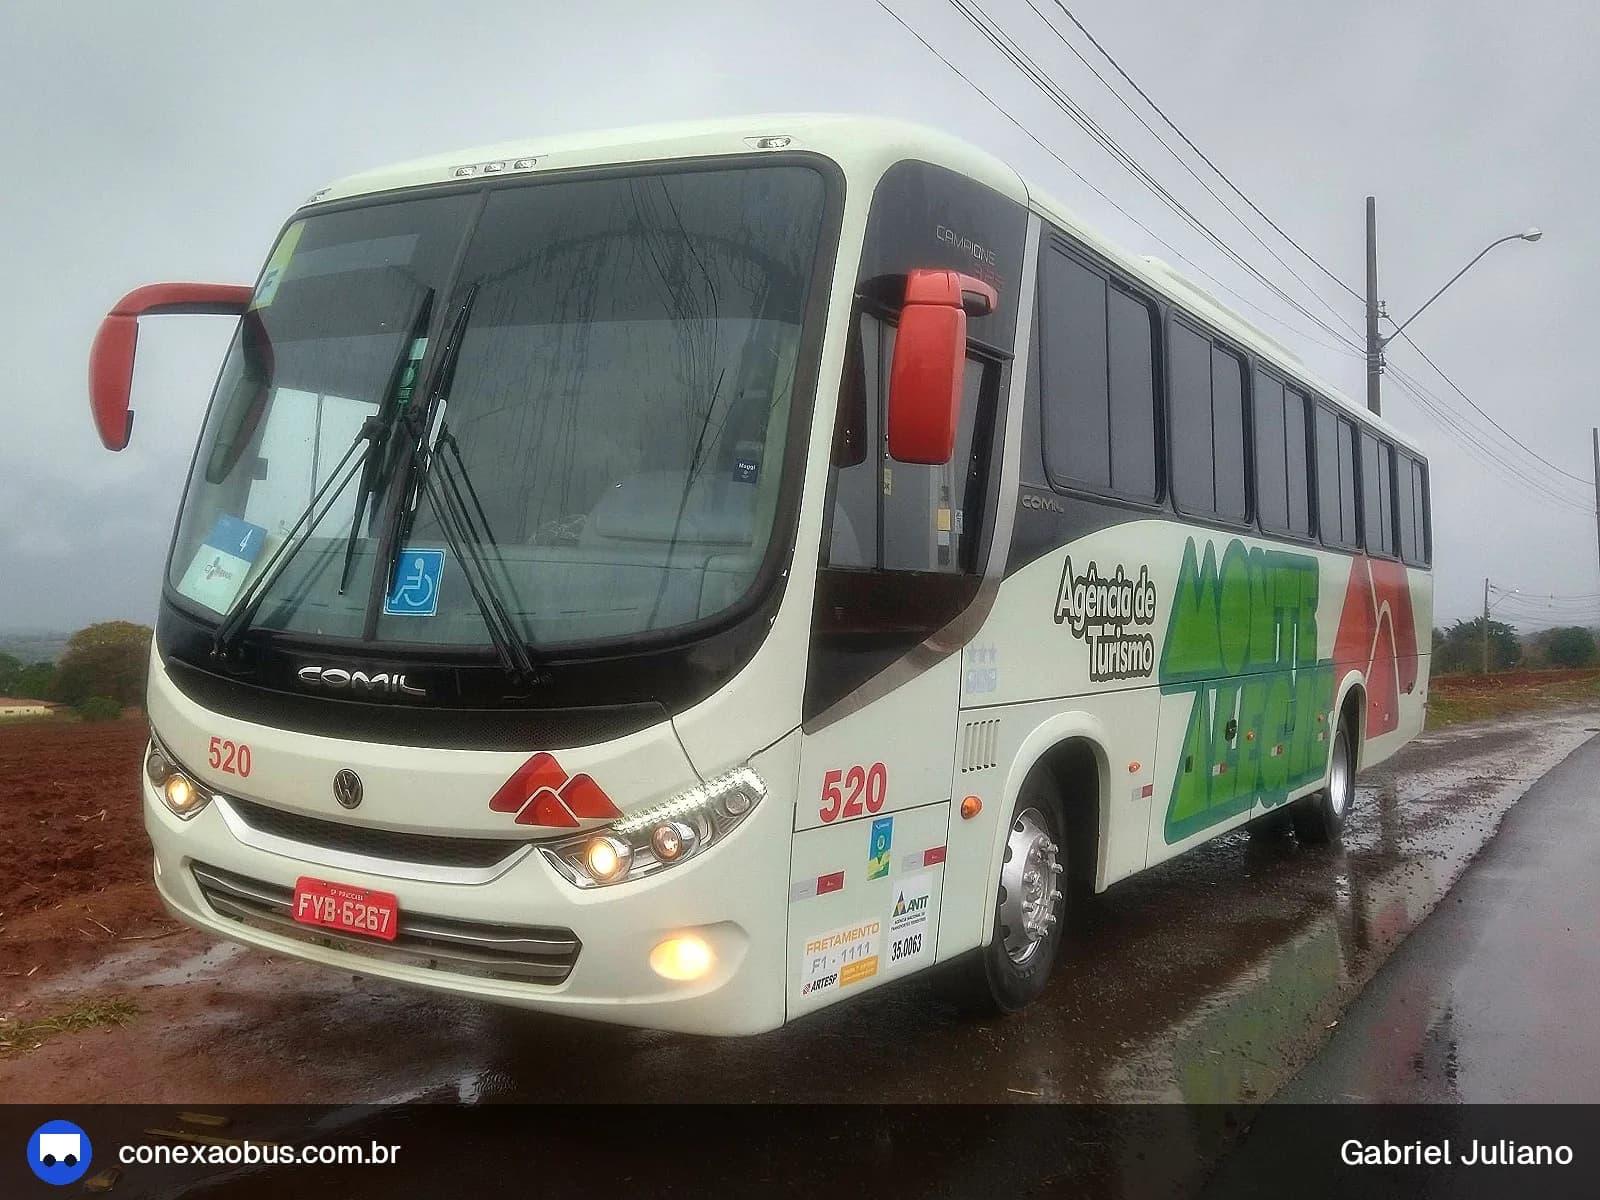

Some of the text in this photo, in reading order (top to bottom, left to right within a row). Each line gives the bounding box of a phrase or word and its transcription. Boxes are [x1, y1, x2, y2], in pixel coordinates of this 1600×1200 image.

[936, 225, 996, 266] CAMPIONE
[1022, 494, 1064, 514] COMIL
[1054, 554, 1157, 639] Agência de
[1160, 536, 1319, 690] MONTE
[1085, 623, 1154, 682] Turismo
[298, 666, 426, 696] COMIL
[208, 736, 251, 778] 520
[818, 762, 887, 823] 520
[907, 895, 929, 913] ANTT
[806, 922, 880, 955] FRETAMENTO
[891, 933, 923, 962] 35.0063
[811, 956, 827, 974] F1
[841, 942, 870, 964] 1111
[810, 973, 838, 993] ARTESP
